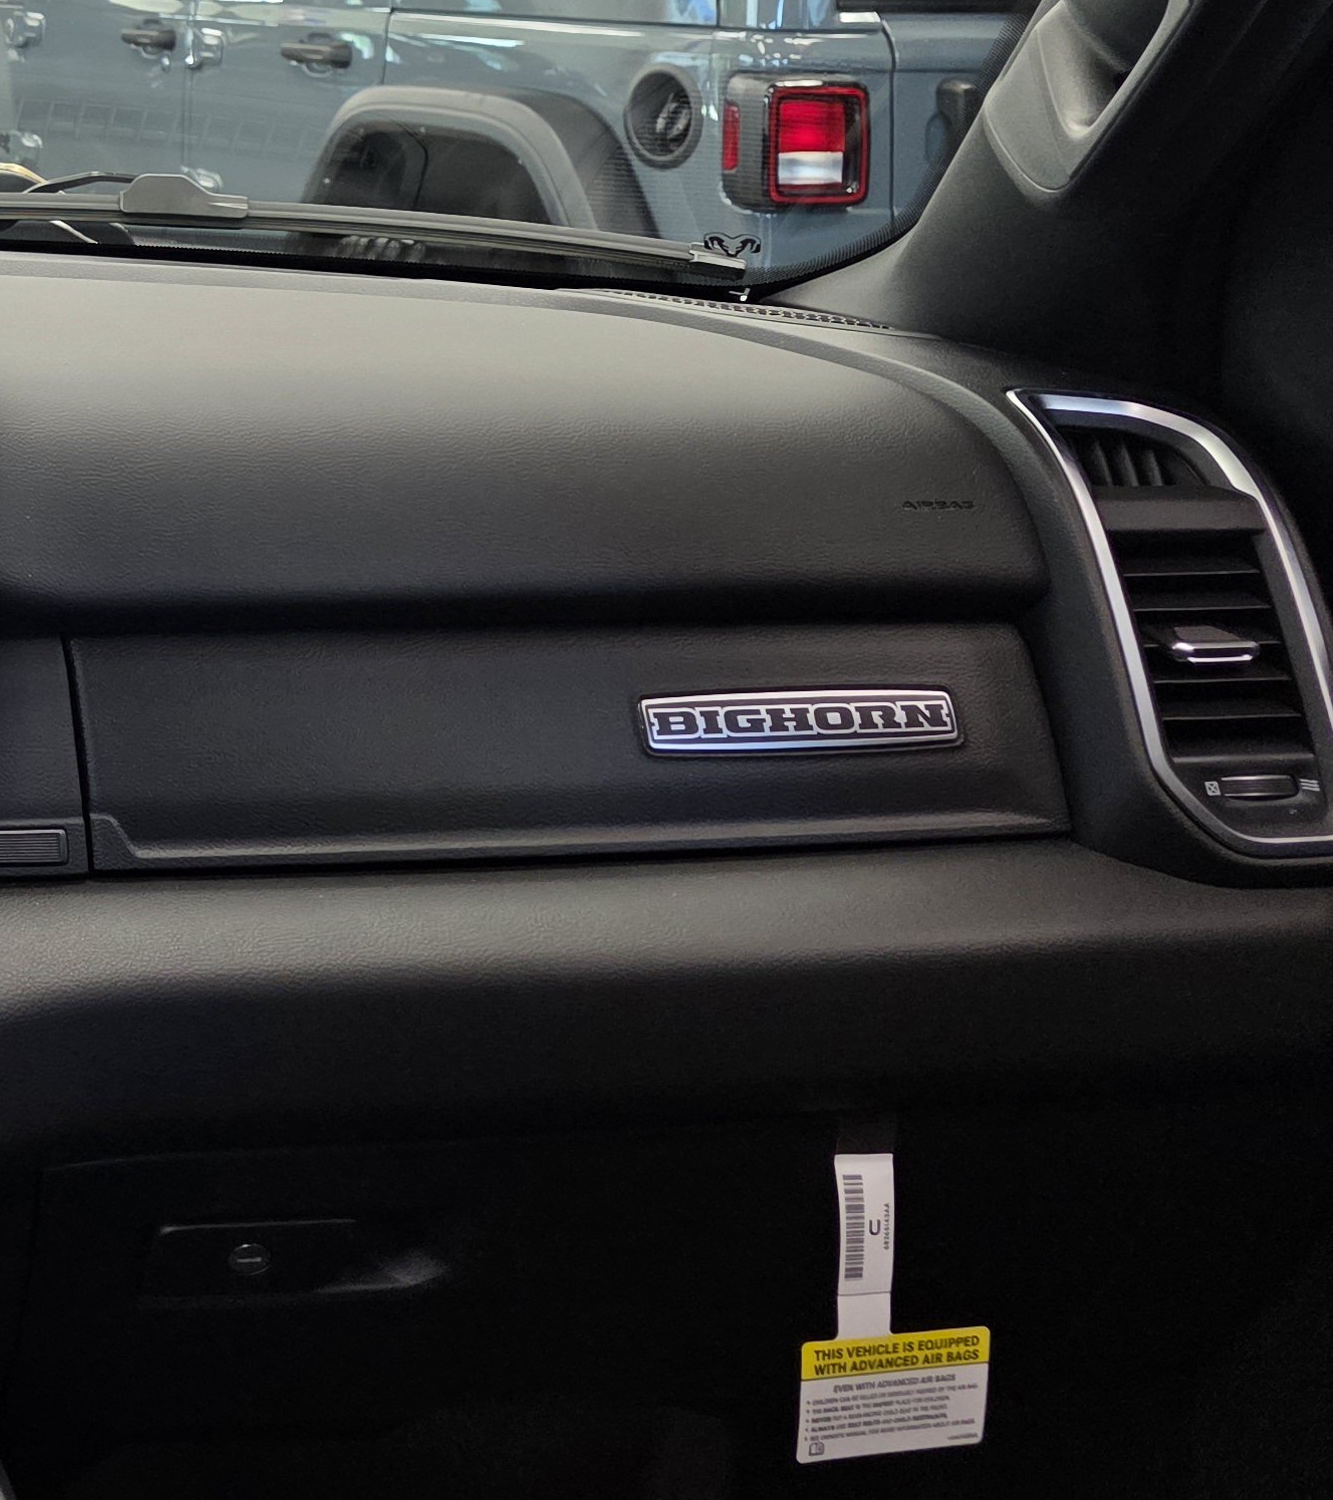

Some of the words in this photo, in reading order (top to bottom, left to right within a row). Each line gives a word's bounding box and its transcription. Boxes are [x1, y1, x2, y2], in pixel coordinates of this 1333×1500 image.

[649, 700, 954, 740] BIGHORN
[869, 1219, 881, 1236] U
[814, 1349, 844, 1361] THIS
[846, 1342, 900, 1358] VEHICLE
[903, 1341, 915, 1352] IS
[918, 1335, 980, 1351] EQUIPPED
[814, 1362, 847, 1376] WITH
[850, 1355, 919, 1372] ADVANCED
[923, 1353, 943, 1365] AIR
[946, 1349, 980, 1361] BAGS
[833, 1384, 854, 1393] EVEN
[855, 1381, 876, 1391] WITH
